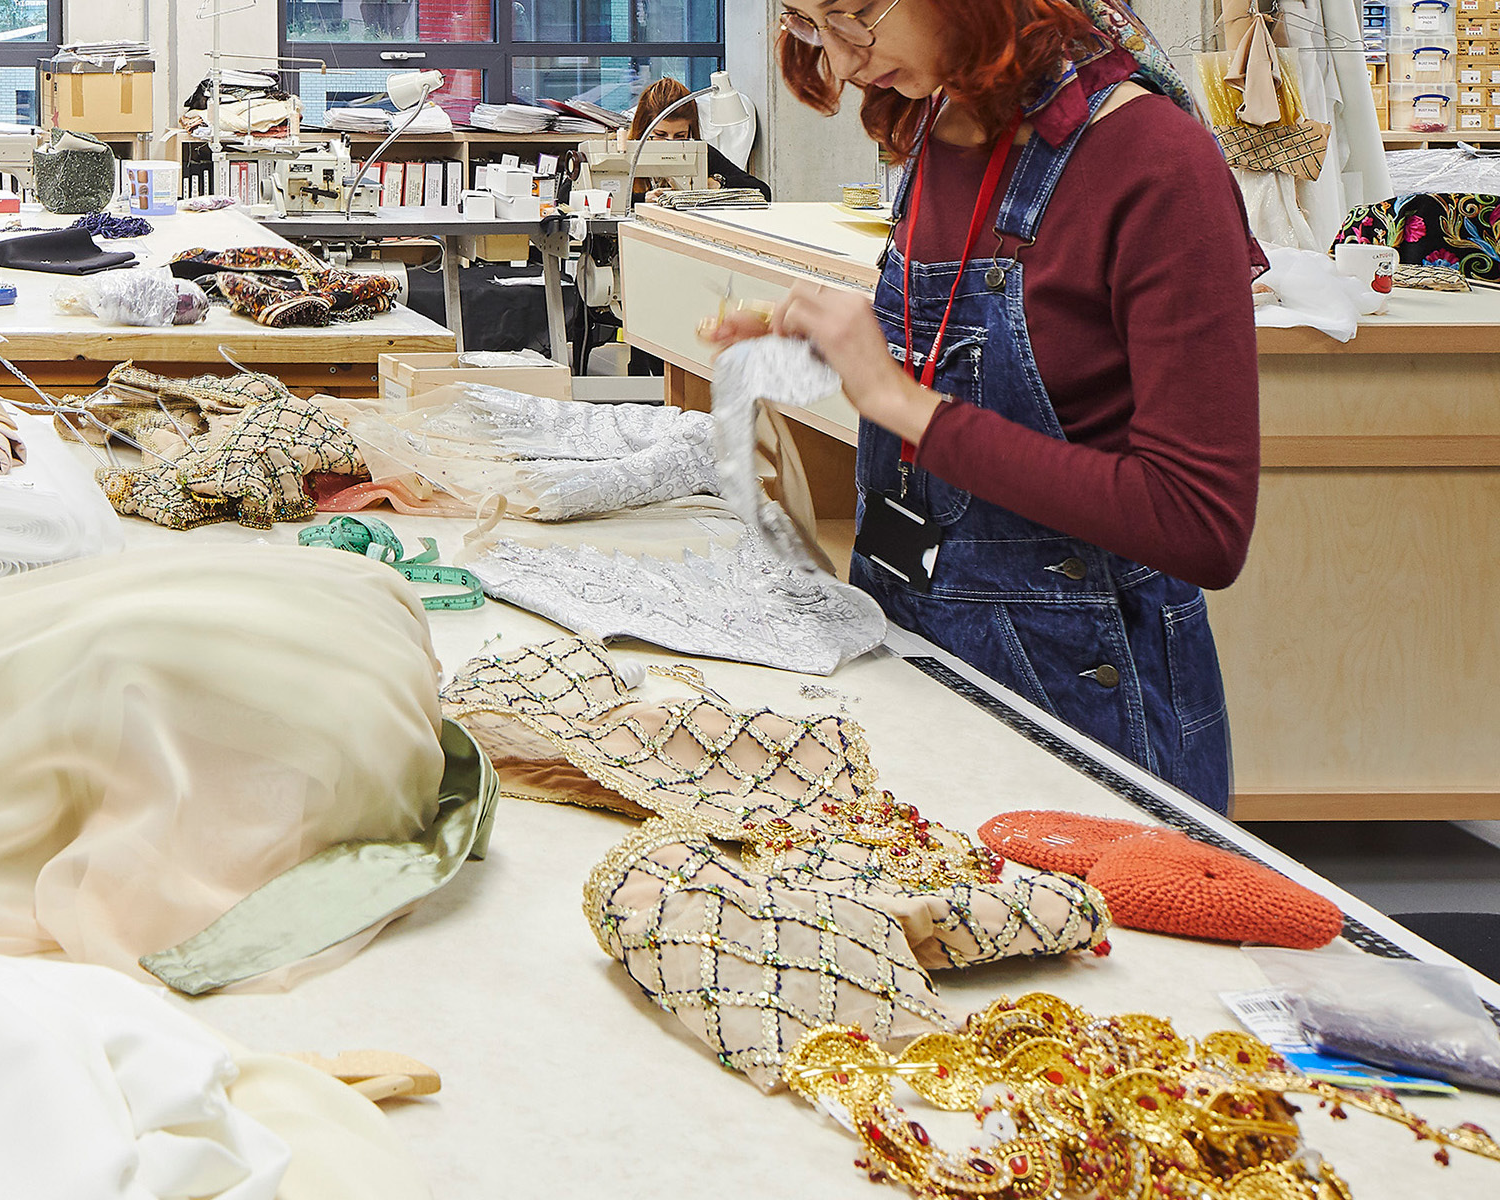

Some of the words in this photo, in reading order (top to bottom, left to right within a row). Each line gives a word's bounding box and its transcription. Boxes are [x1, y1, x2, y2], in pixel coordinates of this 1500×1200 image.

[927, 331, 941, 362] VISITOR
[404, 570, 412, 581] 3
[432, 572, 441, 582] 4
[461, 575, 468, 586] 5
